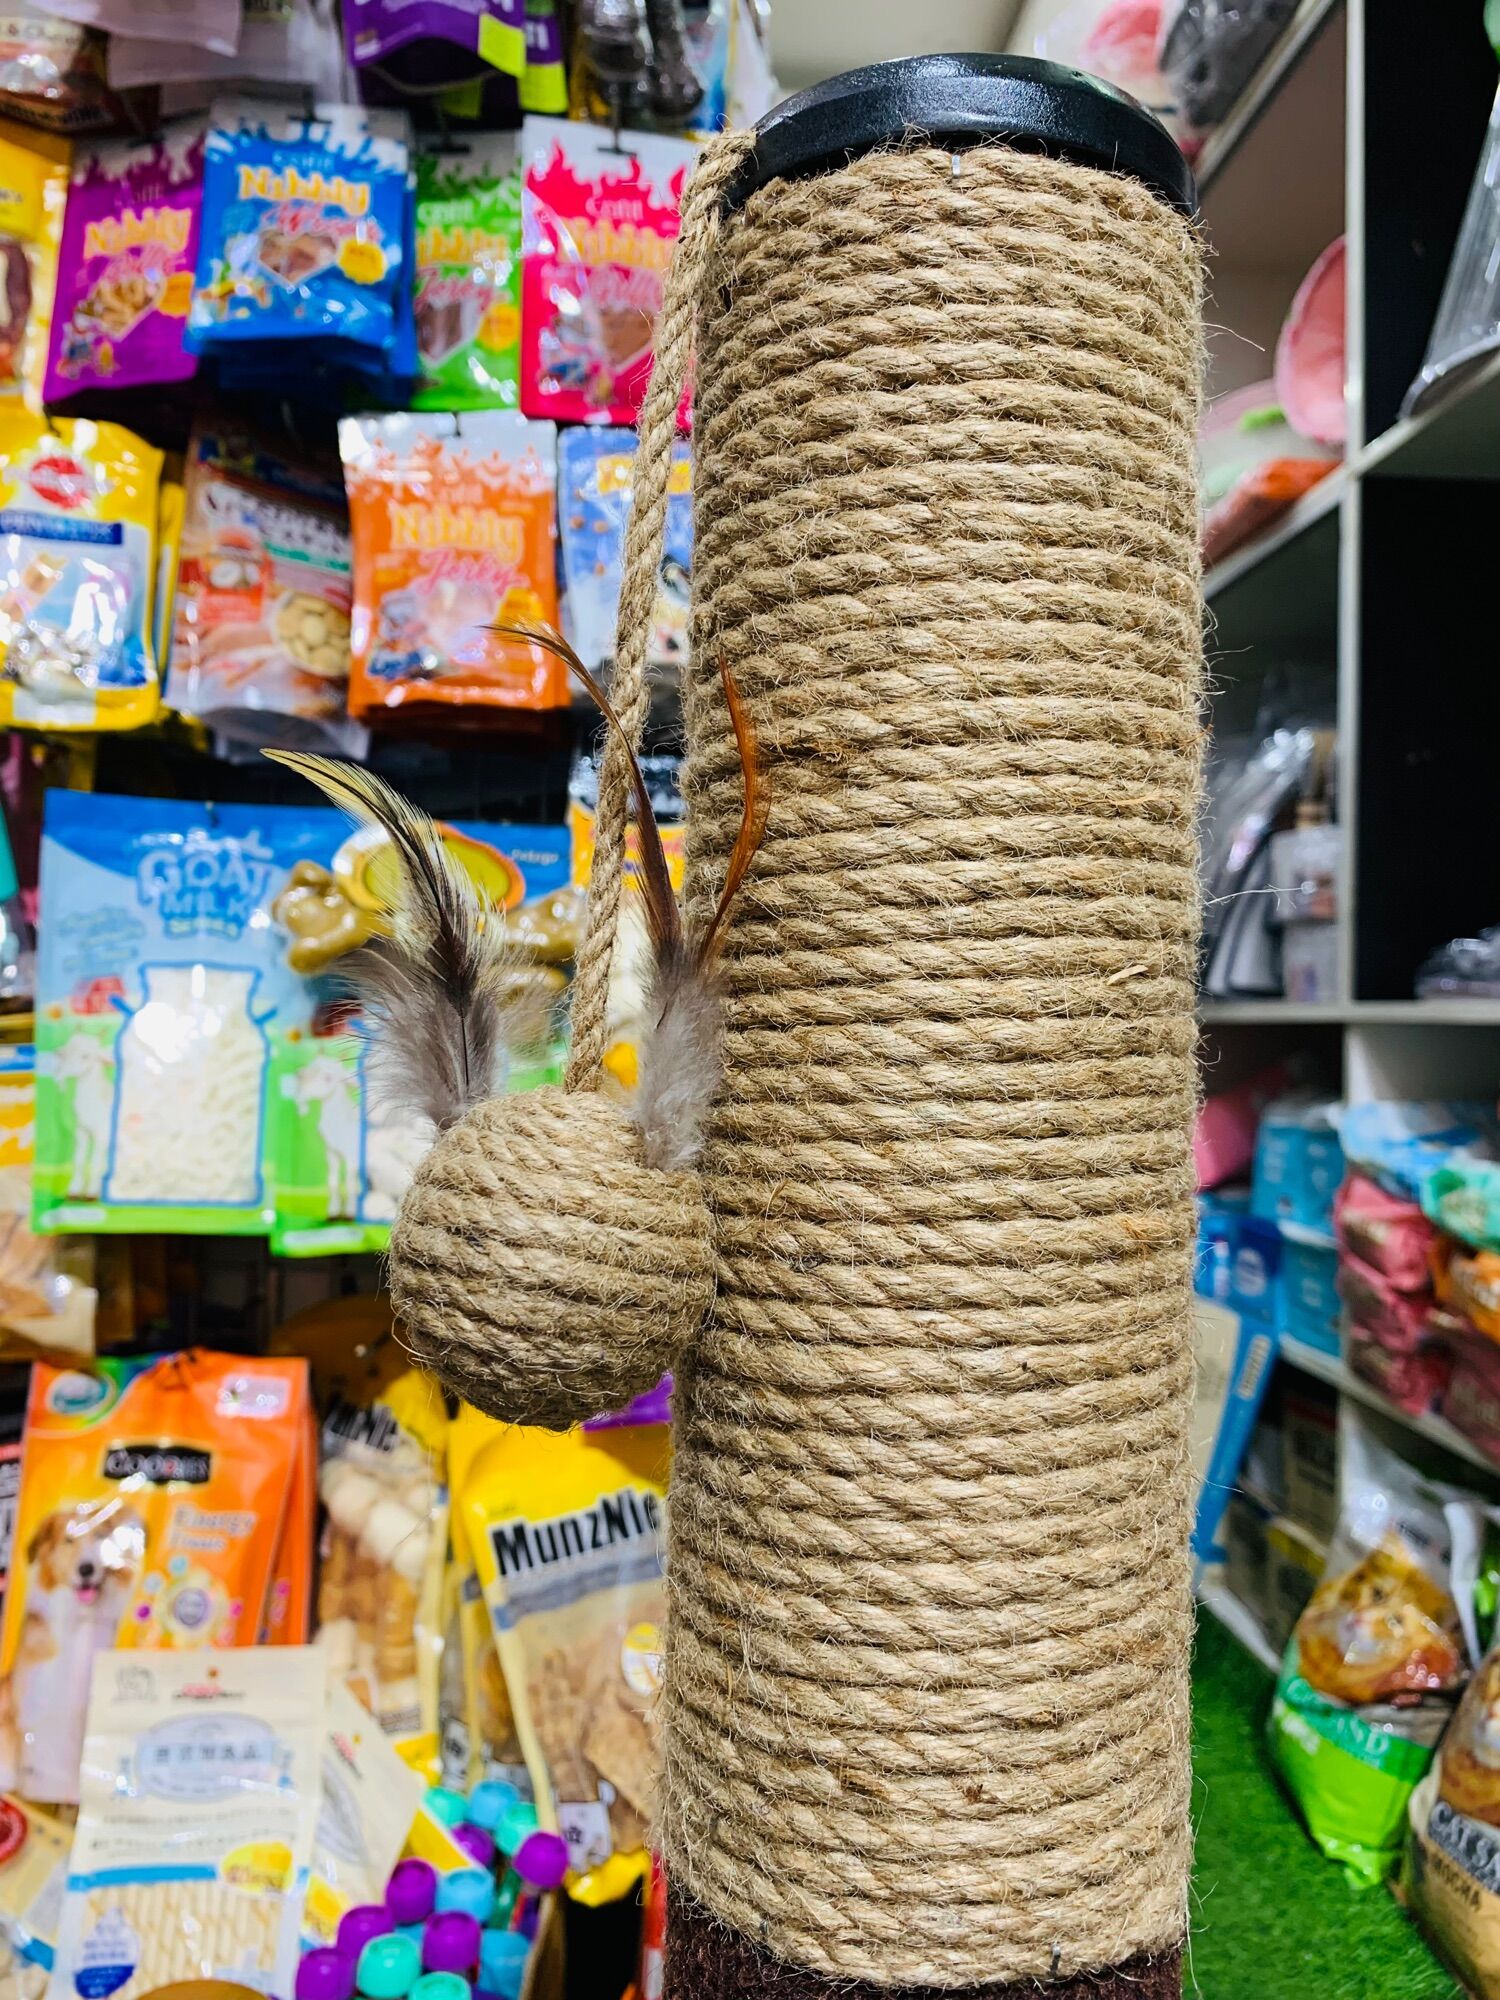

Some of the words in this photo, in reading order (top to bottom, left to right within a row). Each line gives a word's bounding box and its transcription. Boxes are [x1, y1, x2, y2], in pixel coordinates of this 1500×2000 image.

[388, 500, 525, 566] Nibbly
[138, 850, 274, 900] GOAT
[1430, 1801, 1471, 1851] CAT
